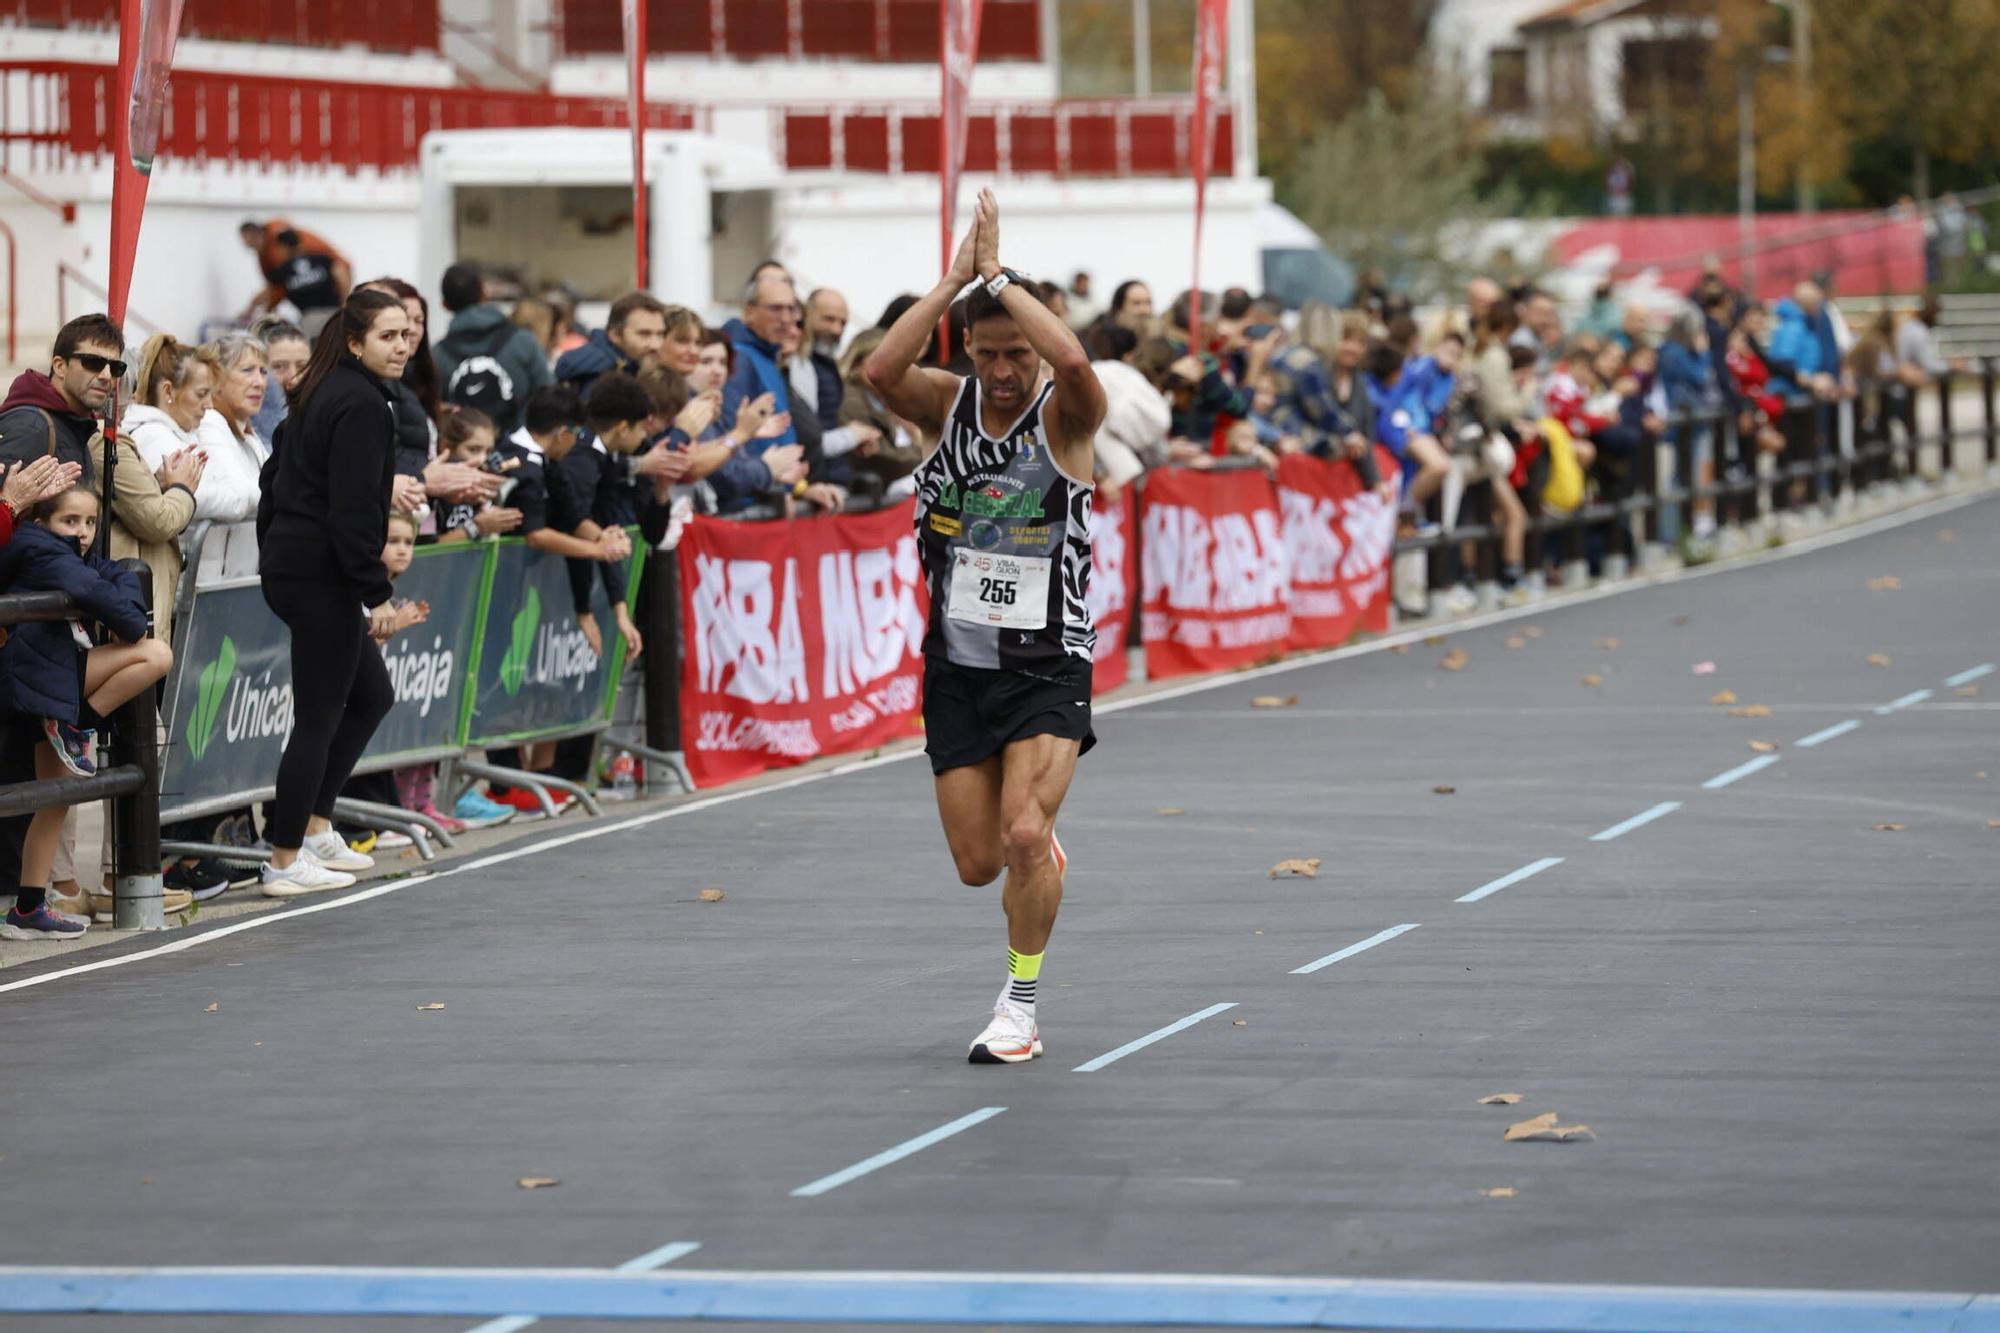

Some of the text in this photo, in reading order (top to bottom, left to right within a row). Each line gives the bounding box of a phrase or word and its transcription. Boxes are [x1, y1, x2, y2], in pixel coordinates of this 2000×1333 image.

[940, 480, 960, 511] LA
[974, 556, 992, 572] 45
[979, 577, 1017, 605] 255
[381, 633, 454, 718] nicaja
[226, 670, 295, 754] Unicaj
